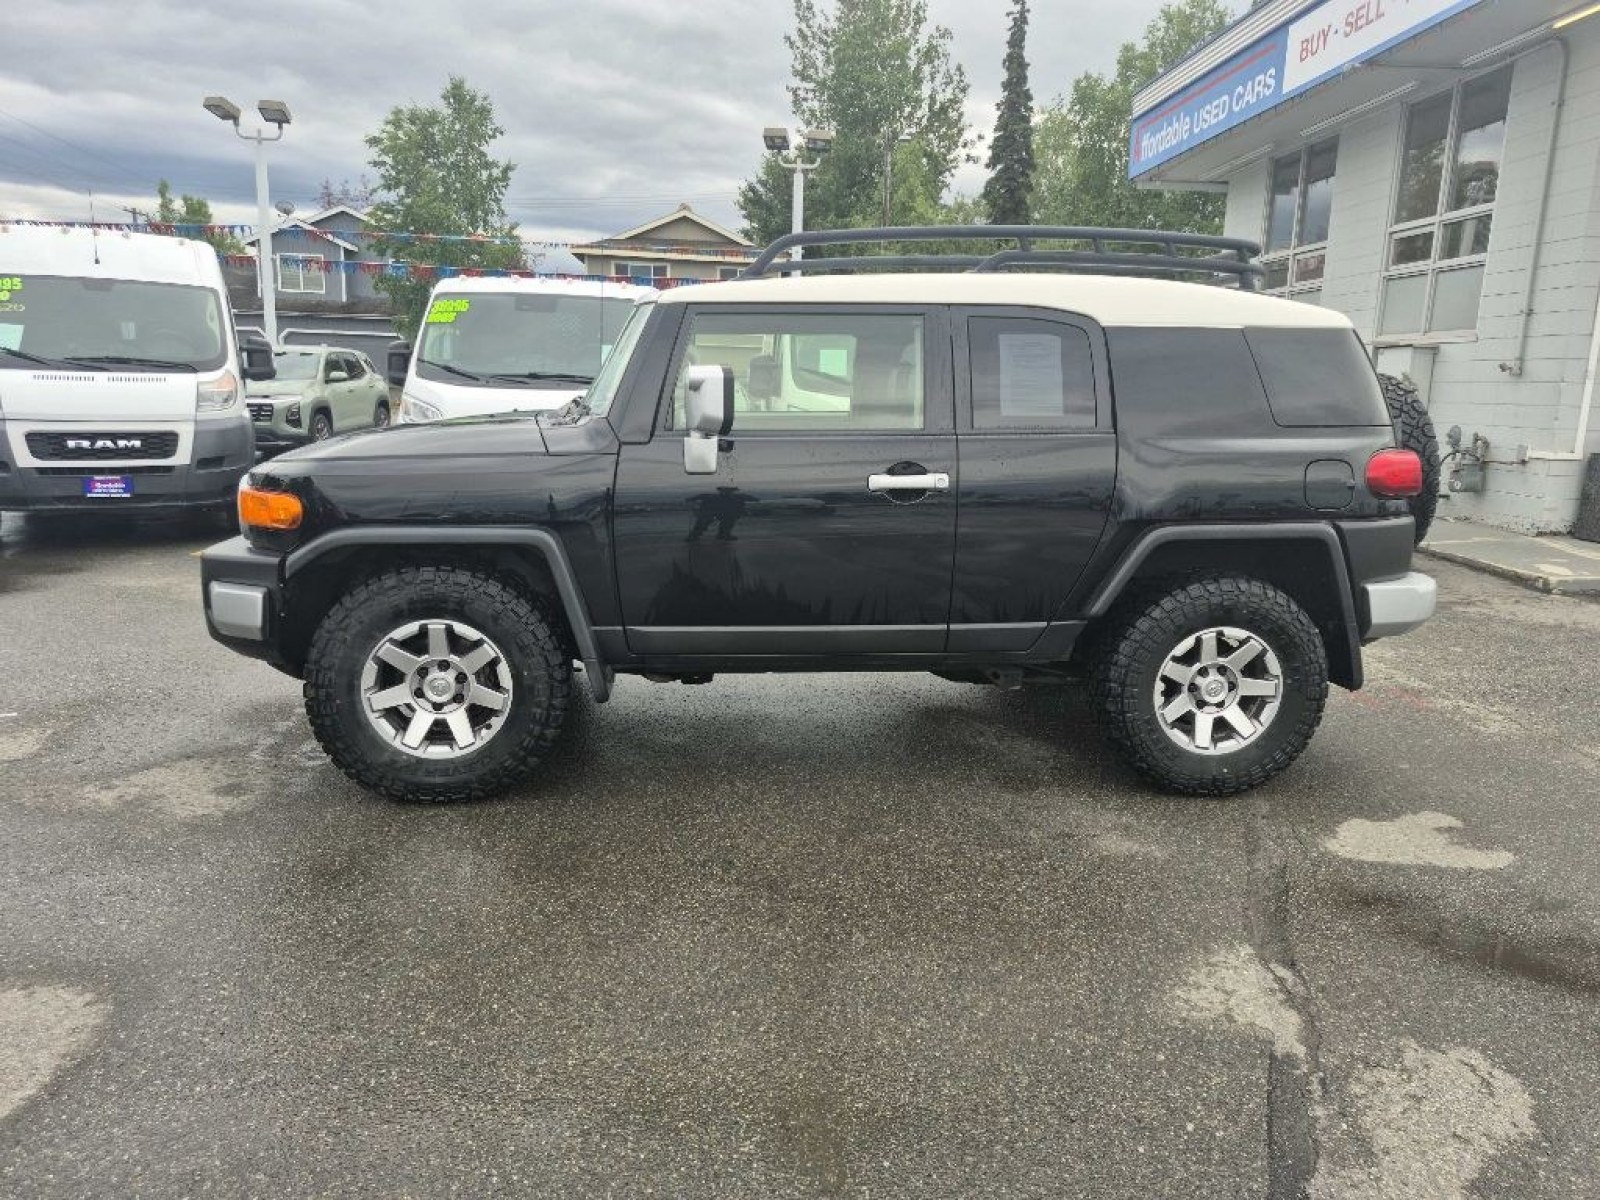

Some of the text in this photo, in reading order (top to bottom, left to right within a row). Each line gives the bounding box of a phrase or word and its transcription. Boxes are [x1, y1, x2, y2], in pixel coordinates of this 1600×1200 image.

[1300, 0, 1385, 63] BUY SELL
[1193, 94, 1230, 133] USED
[1232, 67, 1276, 112] CARS
[0, 277, 22, 290] 95
[66, 439, 141, 449] RAM
